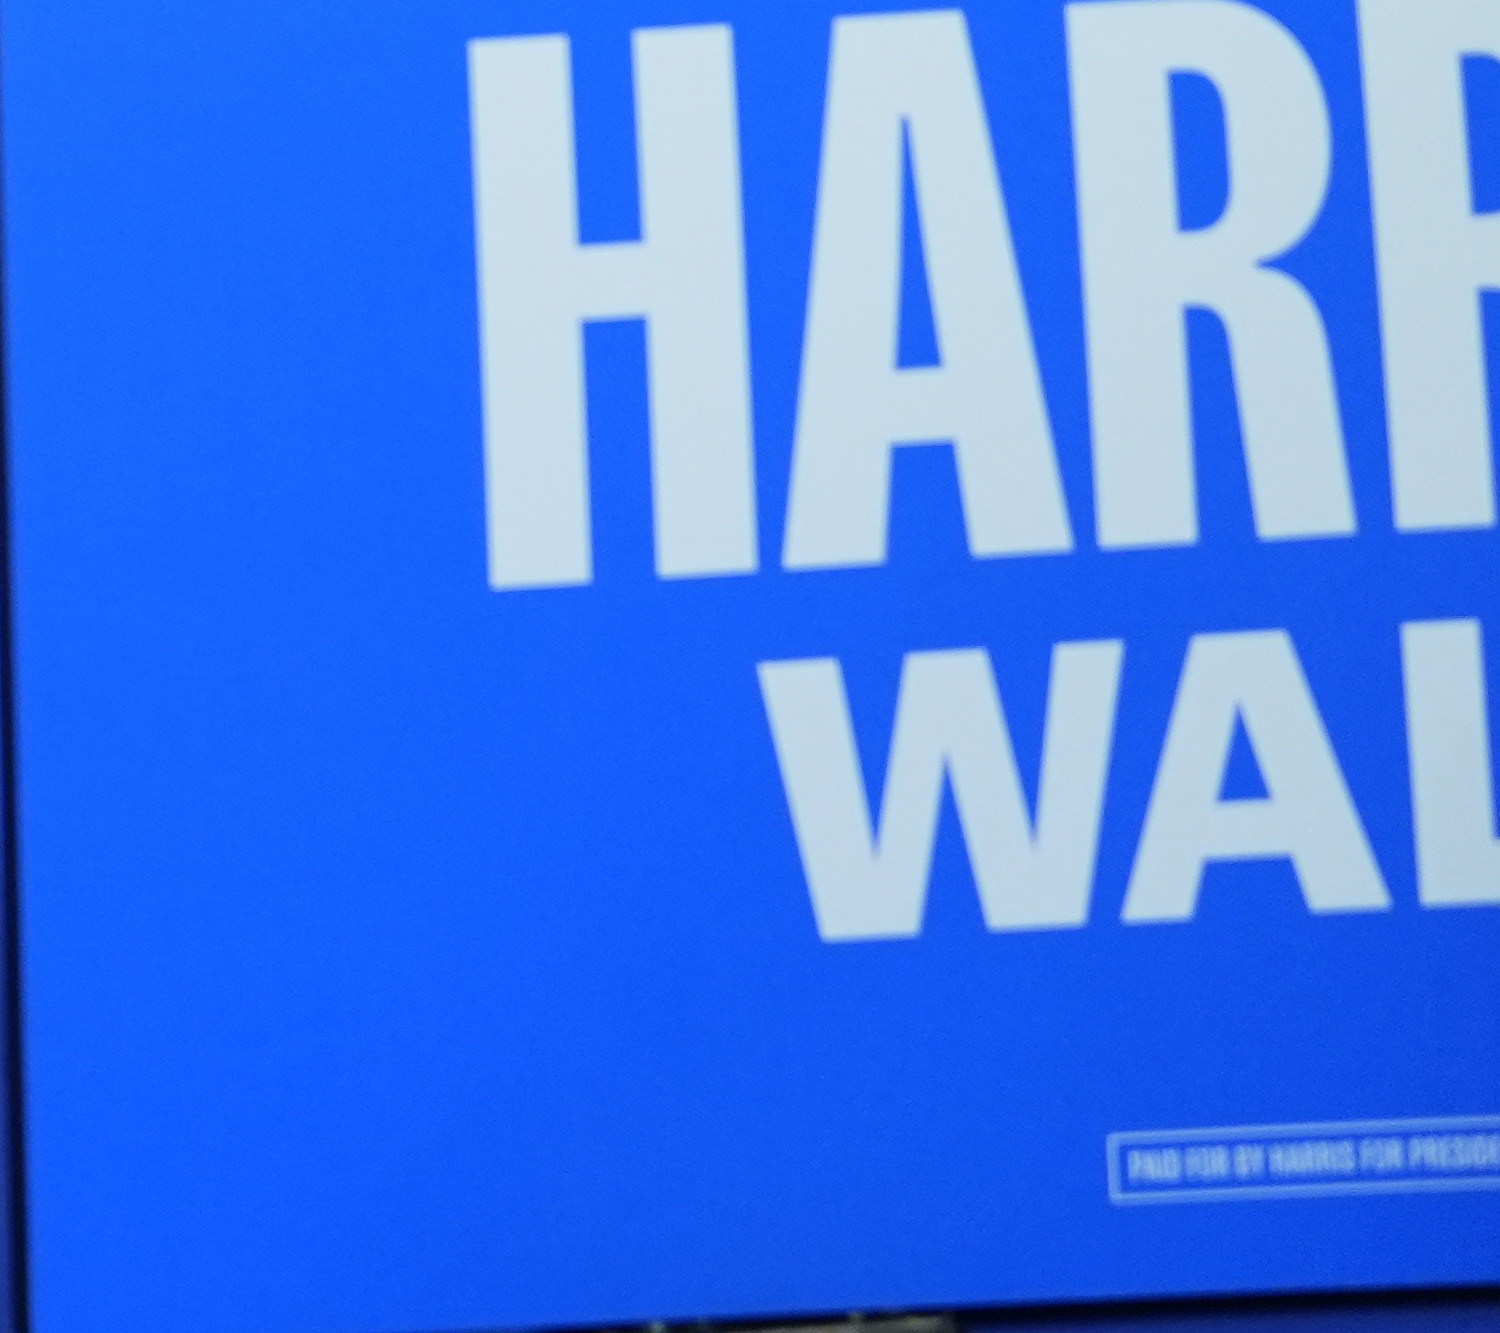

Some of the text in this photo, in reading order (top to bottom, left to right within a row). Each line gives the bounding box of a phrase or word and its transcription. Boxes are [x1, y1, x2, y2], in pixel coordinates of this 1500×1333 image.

[754, 615, 1500, 944] WAL
[1127, 1147, 1182, 1182] PAID
[1185, 1144, 1229, 1180] FOR
[1233, 1143, 1265, 1179] BY
[1268, 1139, 1356, 1177] HARRIS
[1358, 1136, 1404, 1173] FOR
